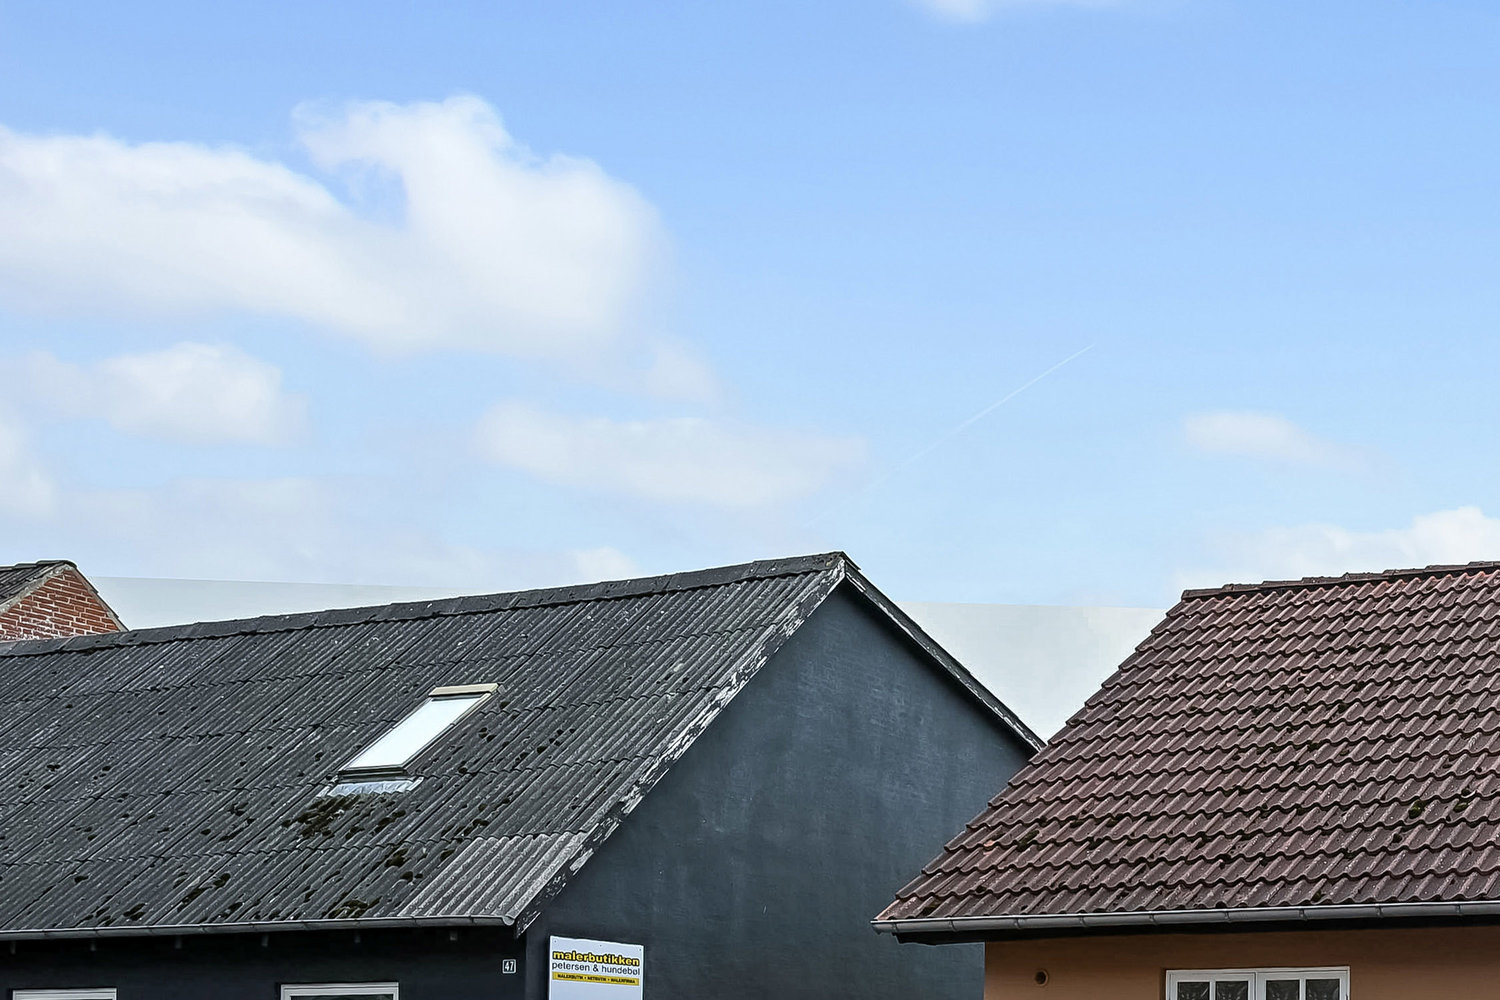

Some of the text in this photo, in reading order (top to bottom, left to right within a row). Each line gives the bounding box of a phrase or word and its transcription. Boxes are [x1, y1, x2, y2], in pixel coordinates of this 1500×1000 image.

[552, 950, 640, 967] malerbutikken
[504, 961, 514, 972] 47
[551, 961, 641, 976] petersen & hundebøl
